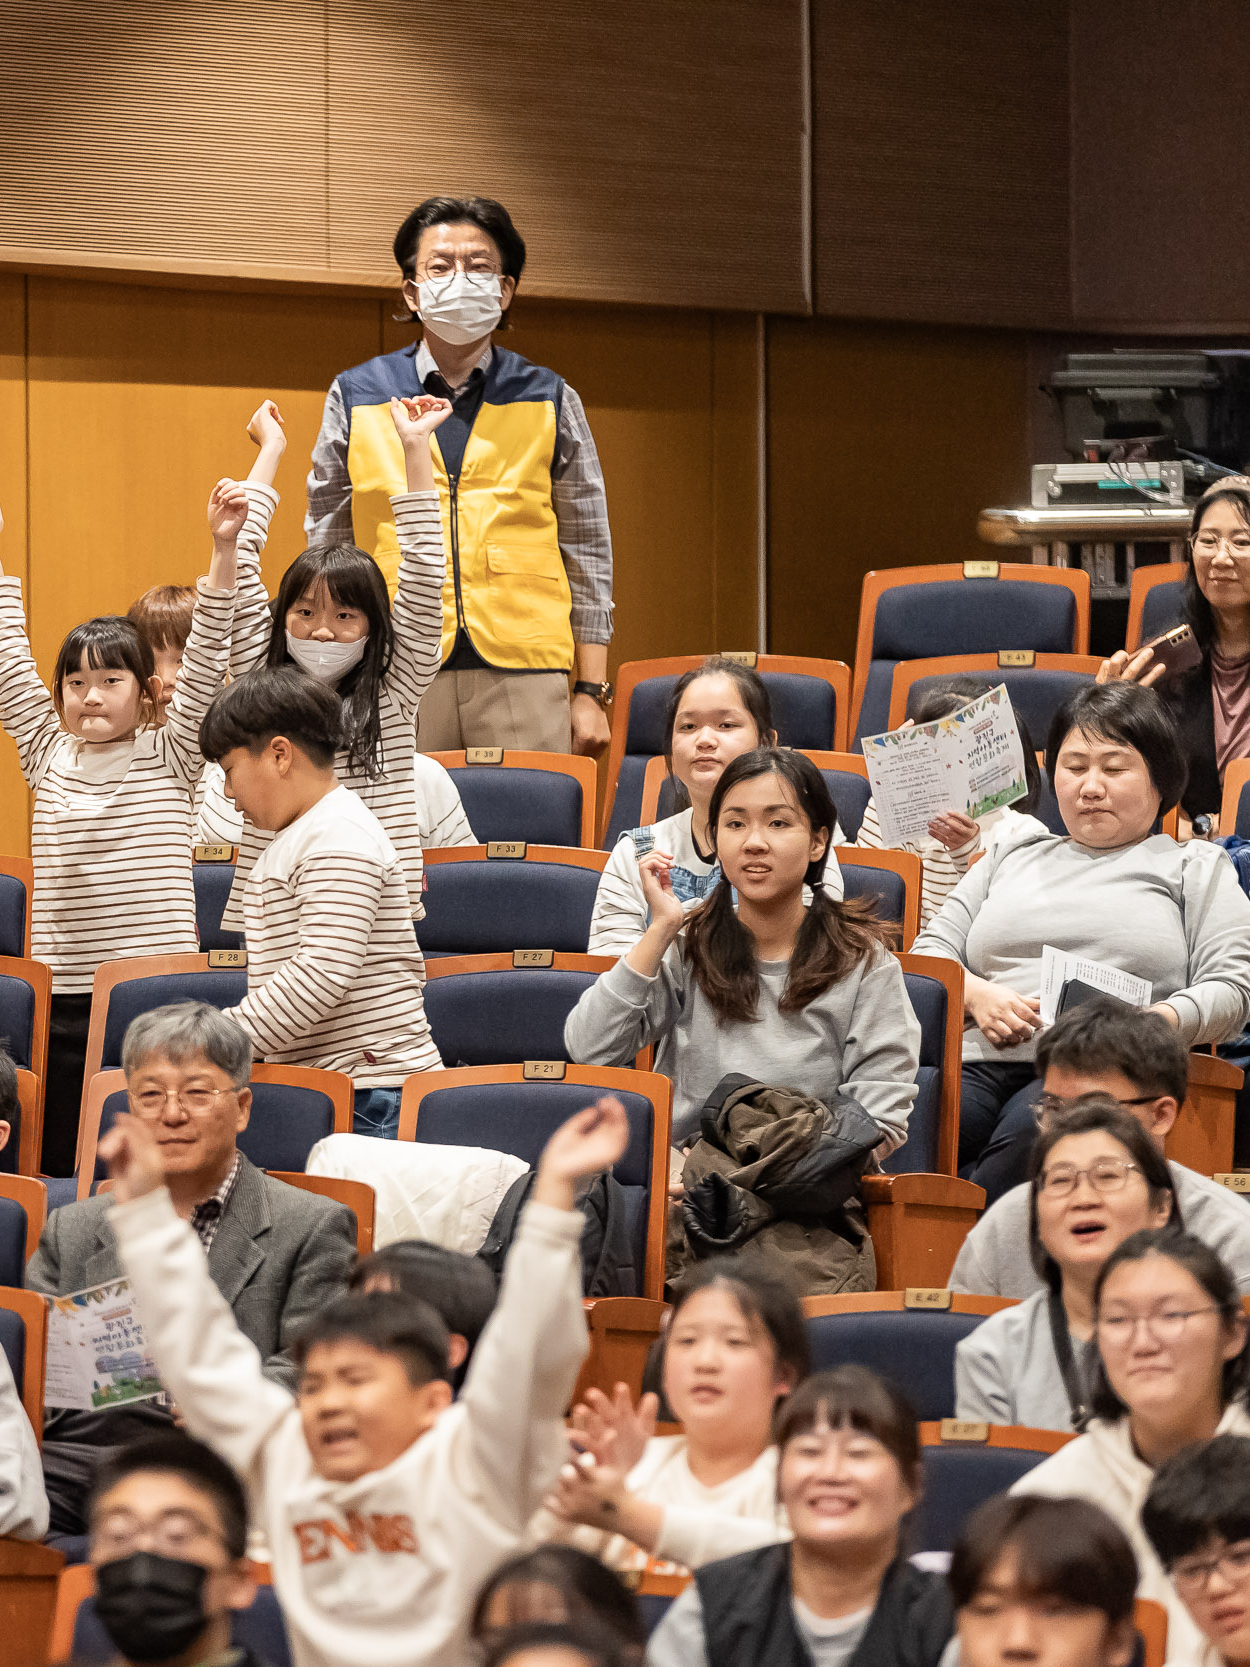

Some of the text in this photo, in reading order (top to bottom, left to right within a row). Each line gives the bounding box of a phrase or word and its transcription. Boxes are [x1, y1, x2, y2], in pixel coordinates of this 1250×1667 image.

[213, 847, 222, 855] 34
[505, 845, 515, 853] 33
[1234, 1178, 1246, 1186] 56
[916, 1293, 921, 1301] E
